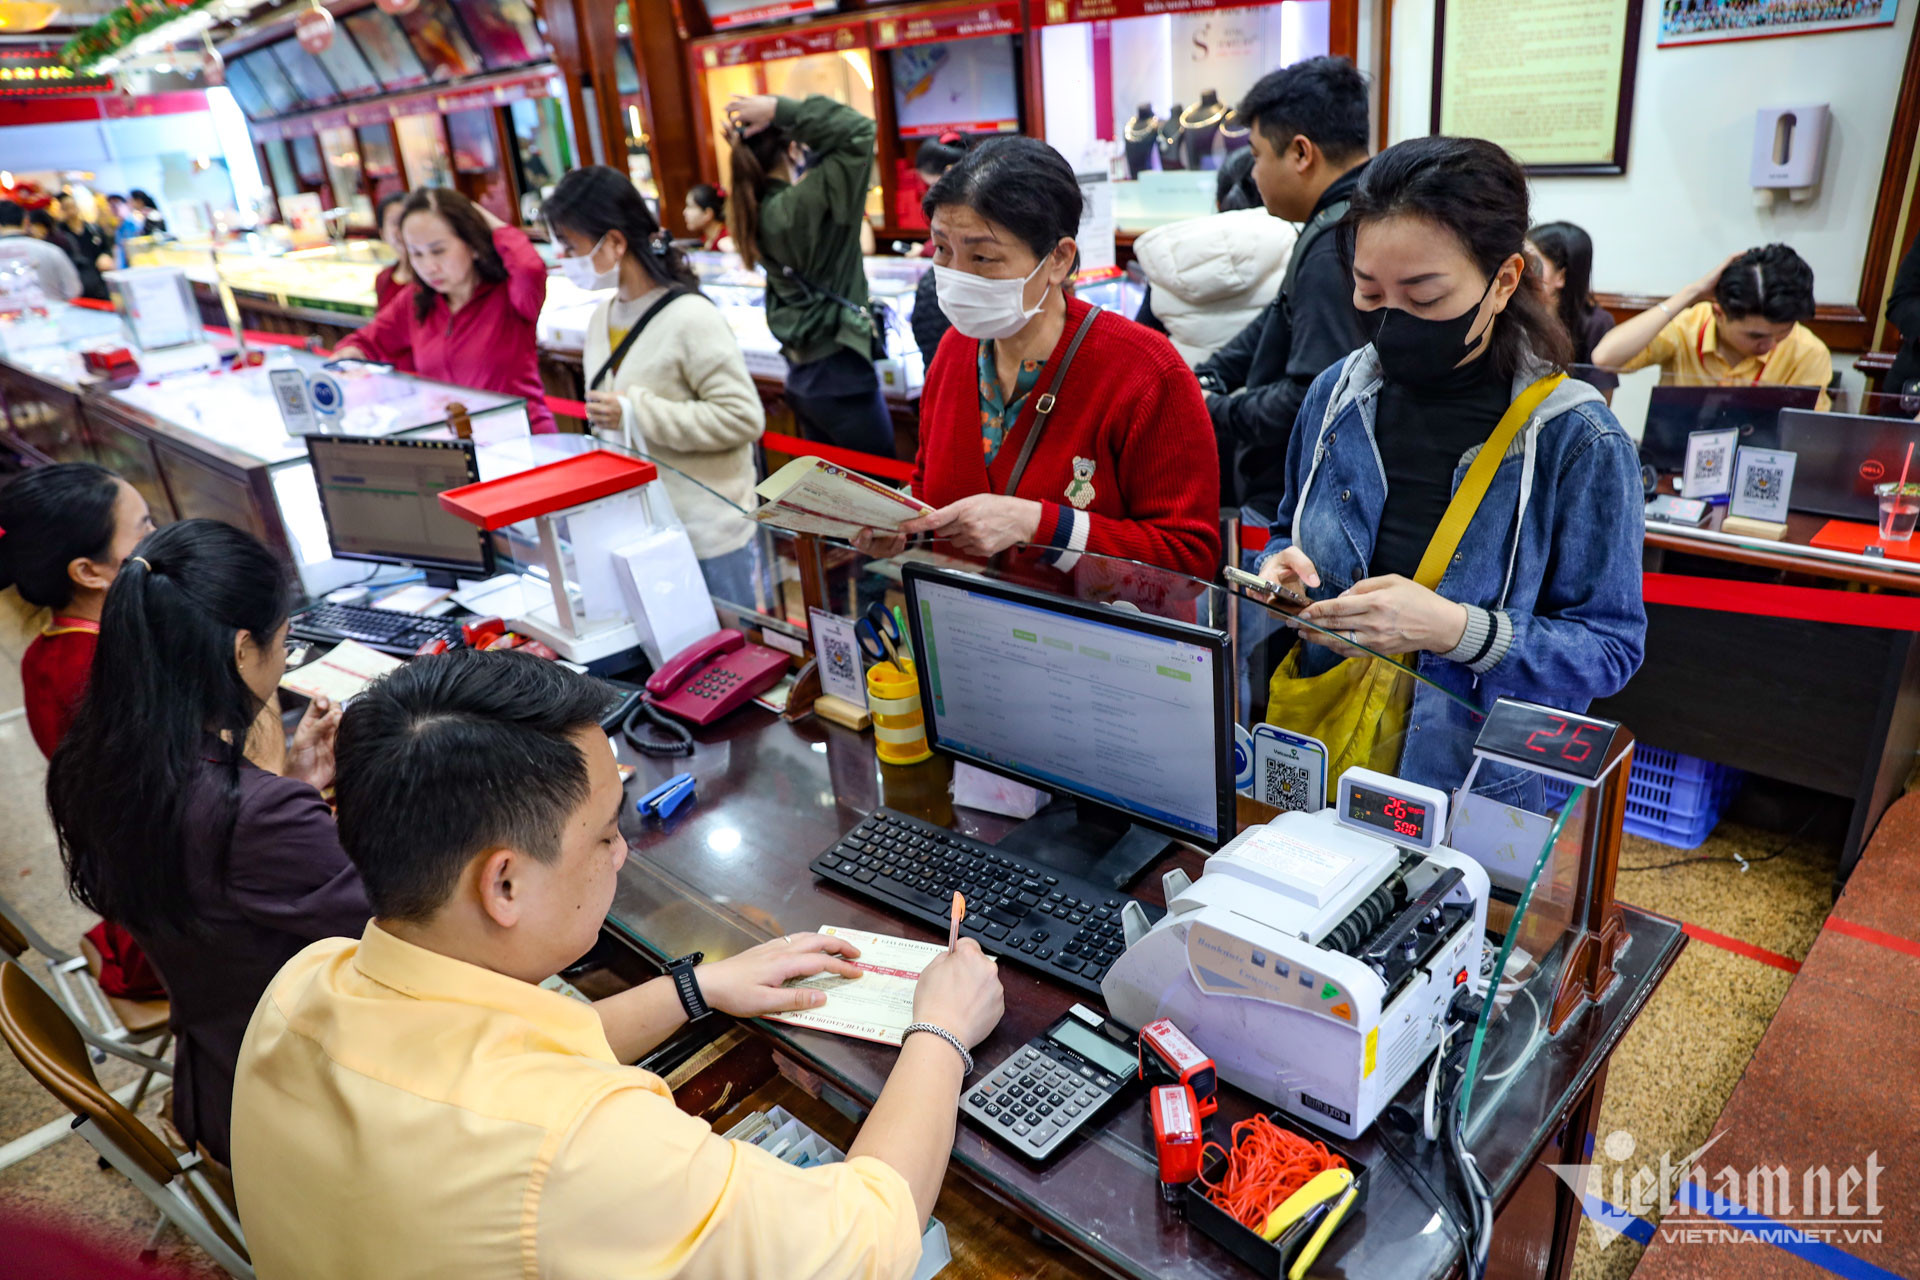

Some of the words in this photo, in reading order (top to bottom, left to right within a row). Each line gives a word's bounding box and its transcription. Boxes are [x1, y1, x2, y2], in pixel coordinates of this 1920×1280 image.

[1523, 715, 1603, 763] 26
[1383, 796, 1408, 820] 26
[1393, 819, 1418, 837] 500
